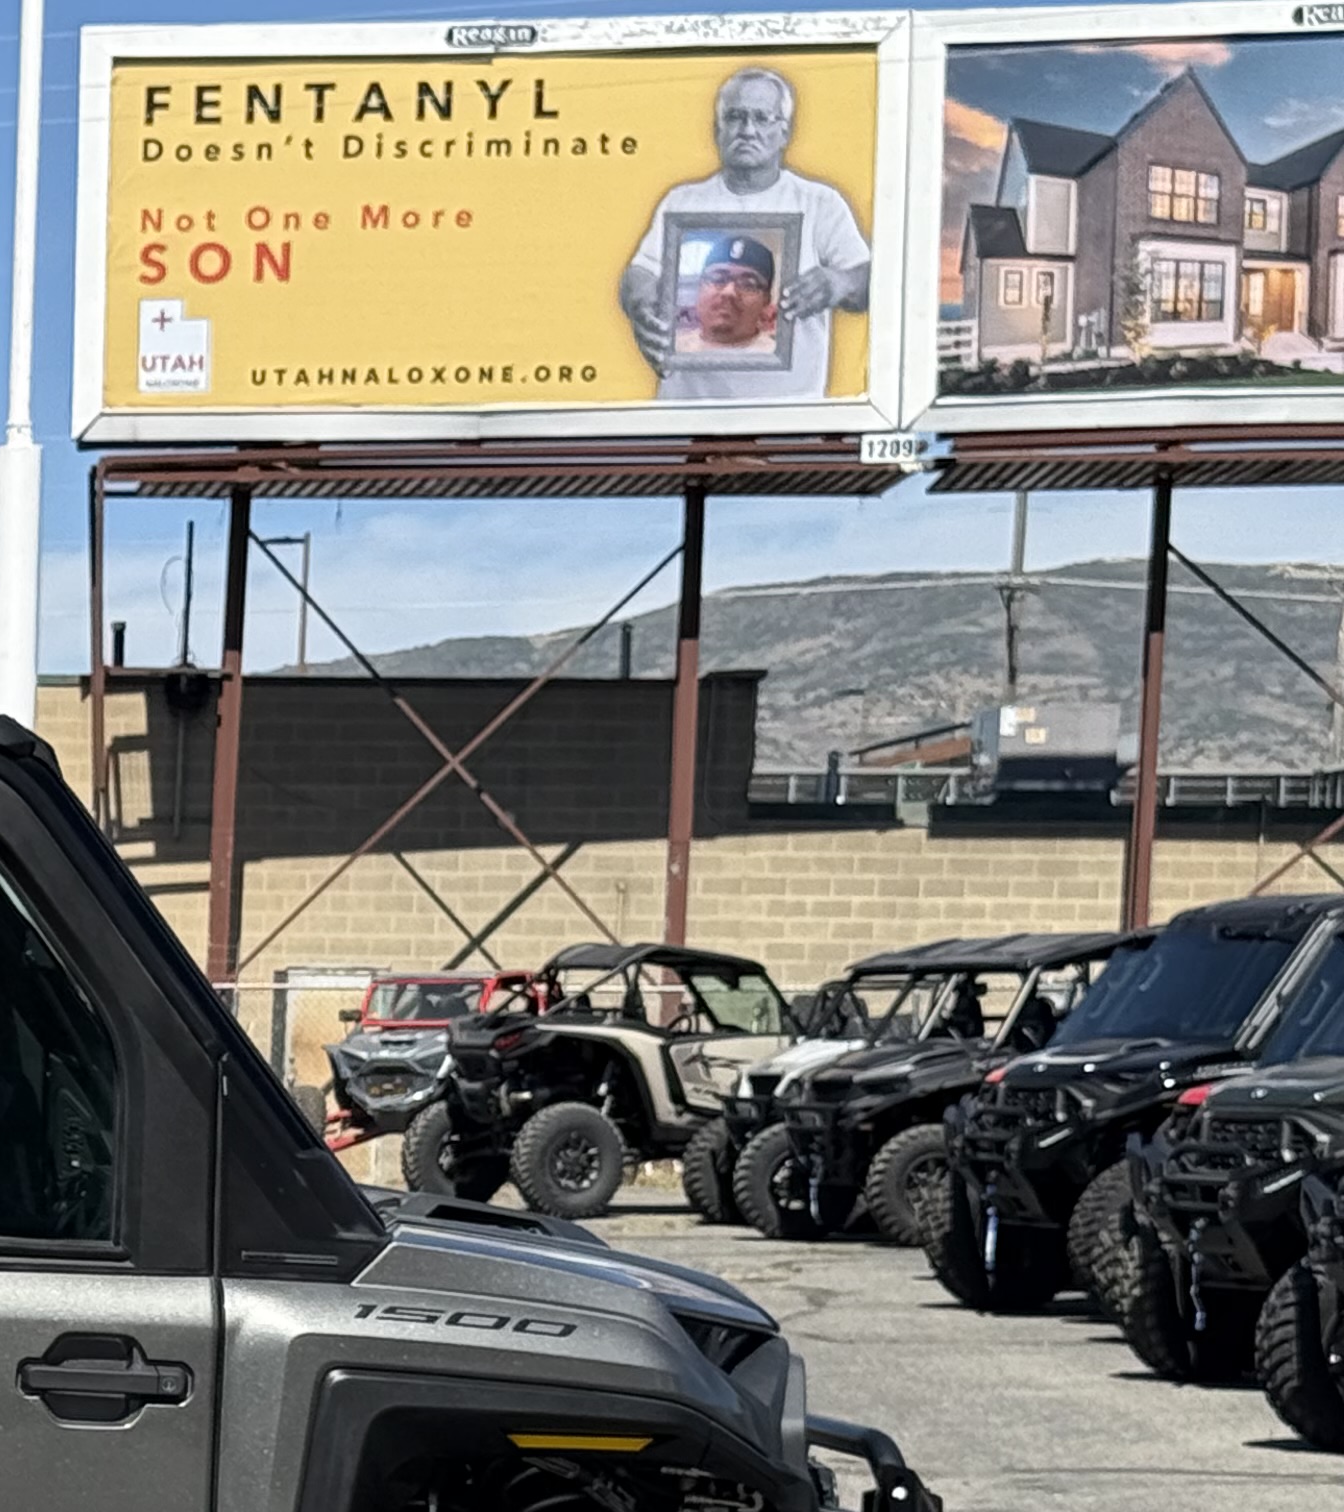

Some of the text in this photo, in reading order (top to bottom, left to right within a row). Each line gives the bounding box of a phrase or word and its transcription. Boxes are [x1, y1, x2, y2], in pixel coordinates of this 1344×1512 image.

[143, 79, 559, 126] FENTANYL
[141, 130, 638, 162] Doesn't Discriminate
[140, 203, 474, 233] Not One More
[138, 240, 293, 285] SON
[141, 354, 205, 373] UTAH
[250, 364, 599, 387] UTAHNALOXONE.ORG
[354, 1303, 578, 1338] 1500
